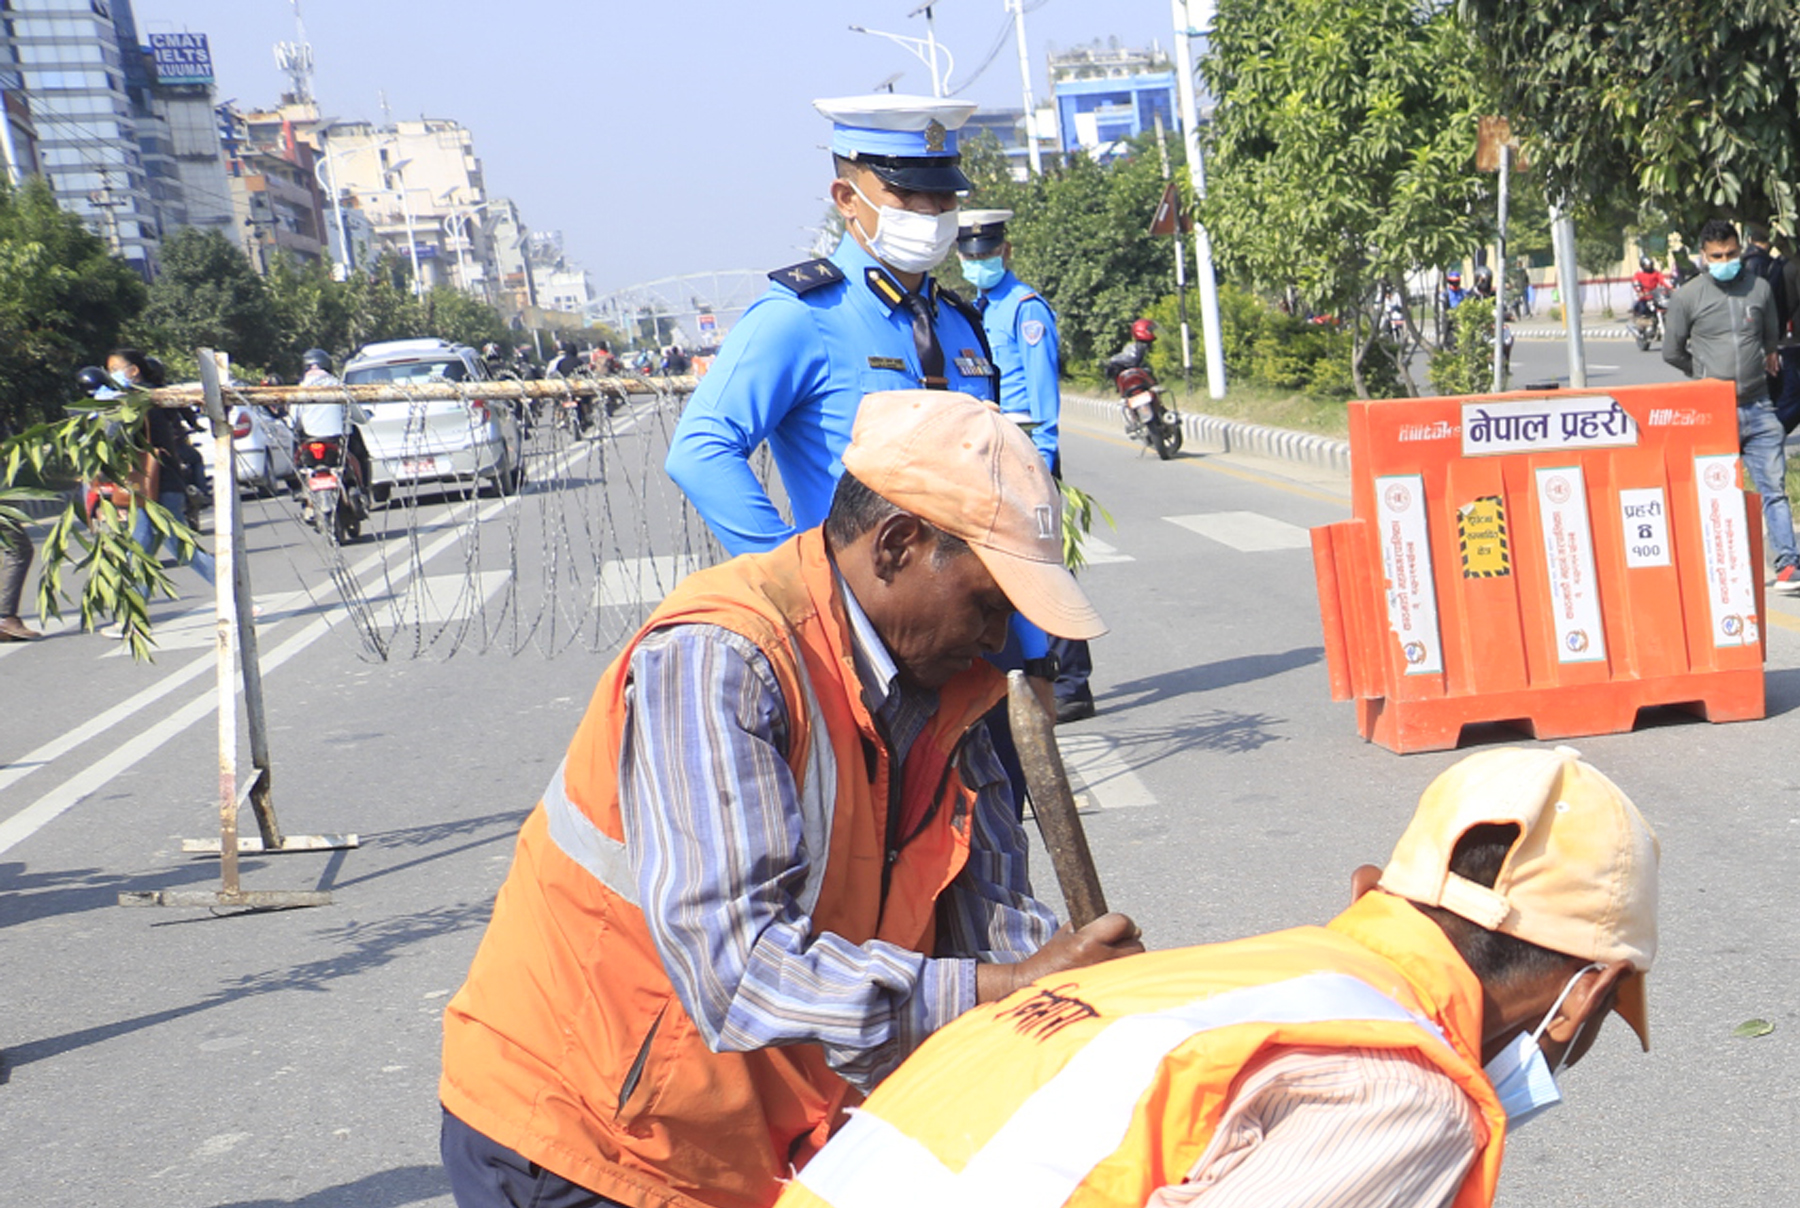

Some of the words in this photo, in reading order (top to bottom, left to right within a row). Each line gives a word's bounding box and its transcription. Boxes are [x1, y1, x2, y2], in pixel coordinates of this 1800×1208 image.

[152, 34, 204, 48] CMAT
[154, 48, 209, 63] IELTS
[156, 63, 212, 76] KUUMAT
[1468, 408, 1550, 443] नेपाल
[1560, 400, 1628, 442] प्रहरी
[1624, 500, 1661, 519] प्रहरी
[1632, 545, 1661, 557] १००
